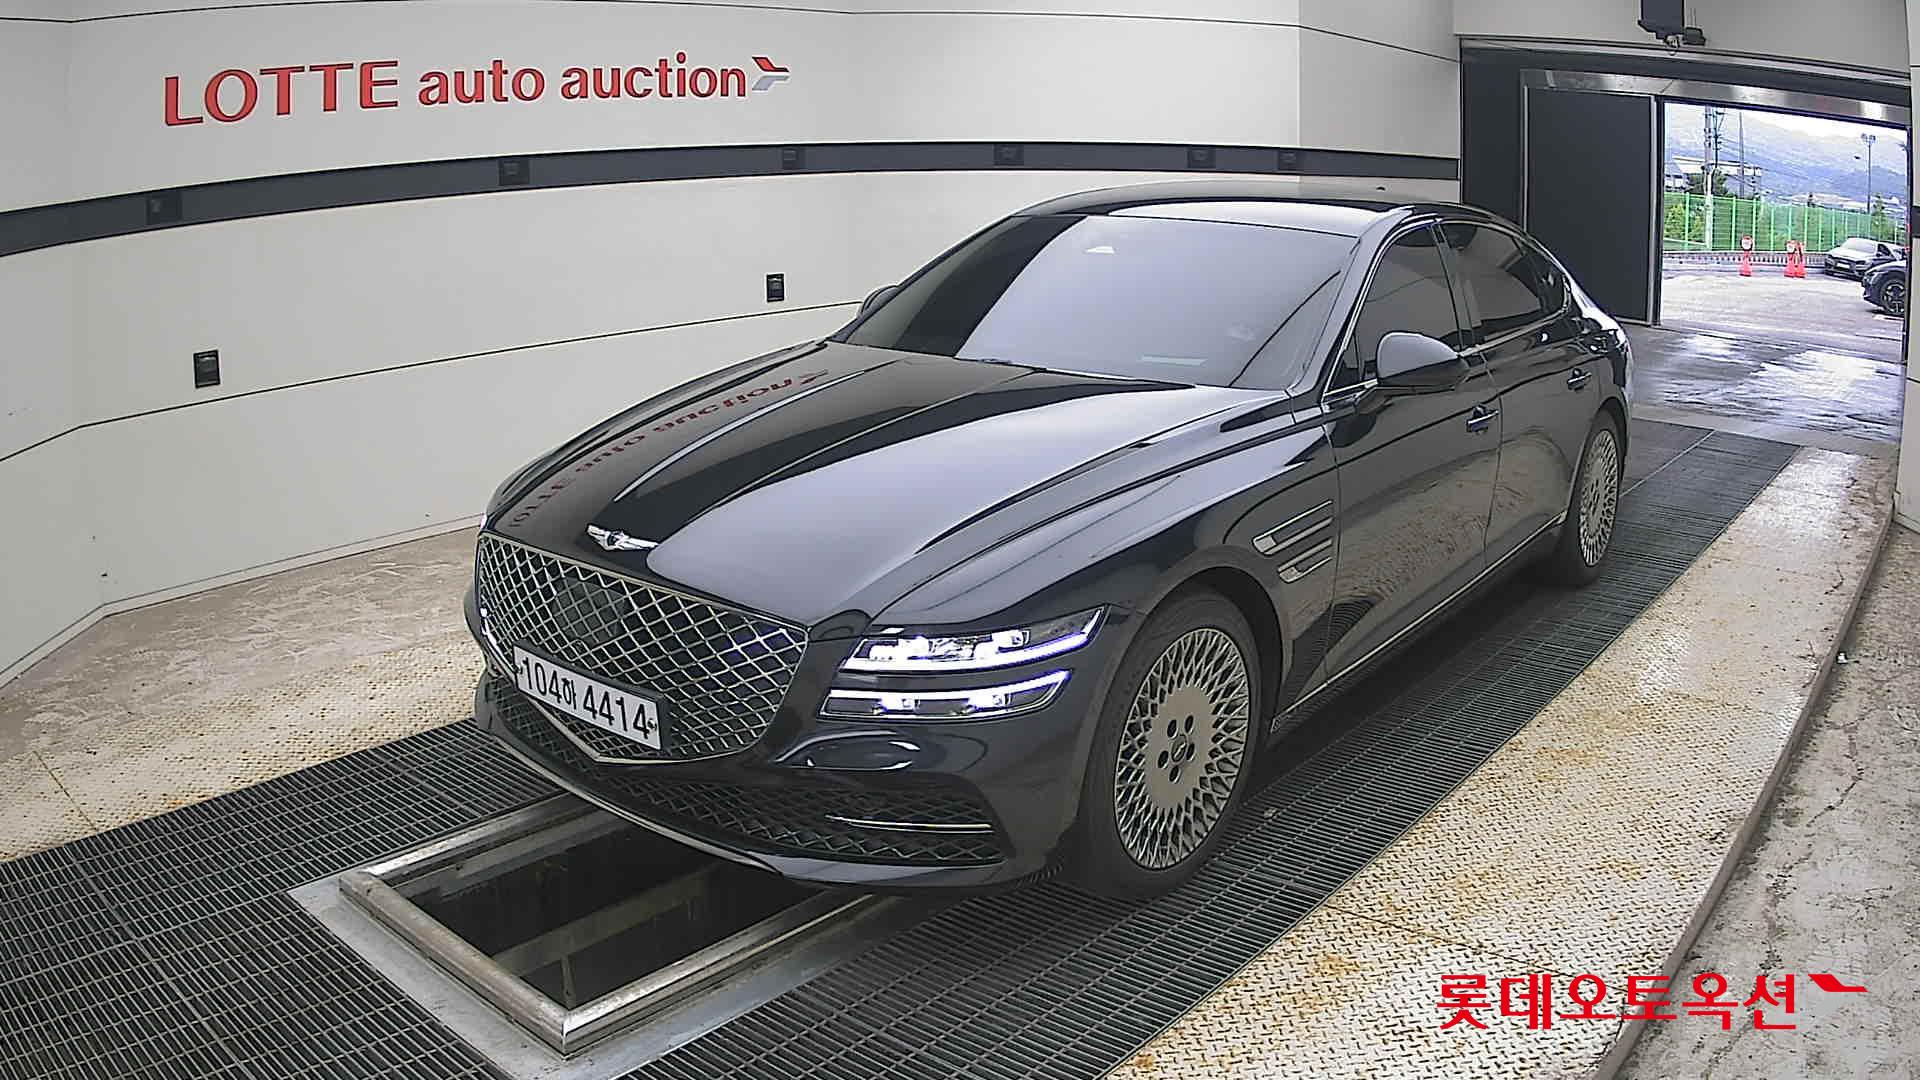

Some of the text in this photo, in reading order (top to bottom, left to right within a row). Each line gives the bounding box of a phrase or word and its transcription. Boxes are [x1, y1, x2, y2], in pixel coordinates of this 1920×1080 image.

[164, 52, 746, 126] LOTTE auto auction
[522, 656, 650, 740] 104하 4414
